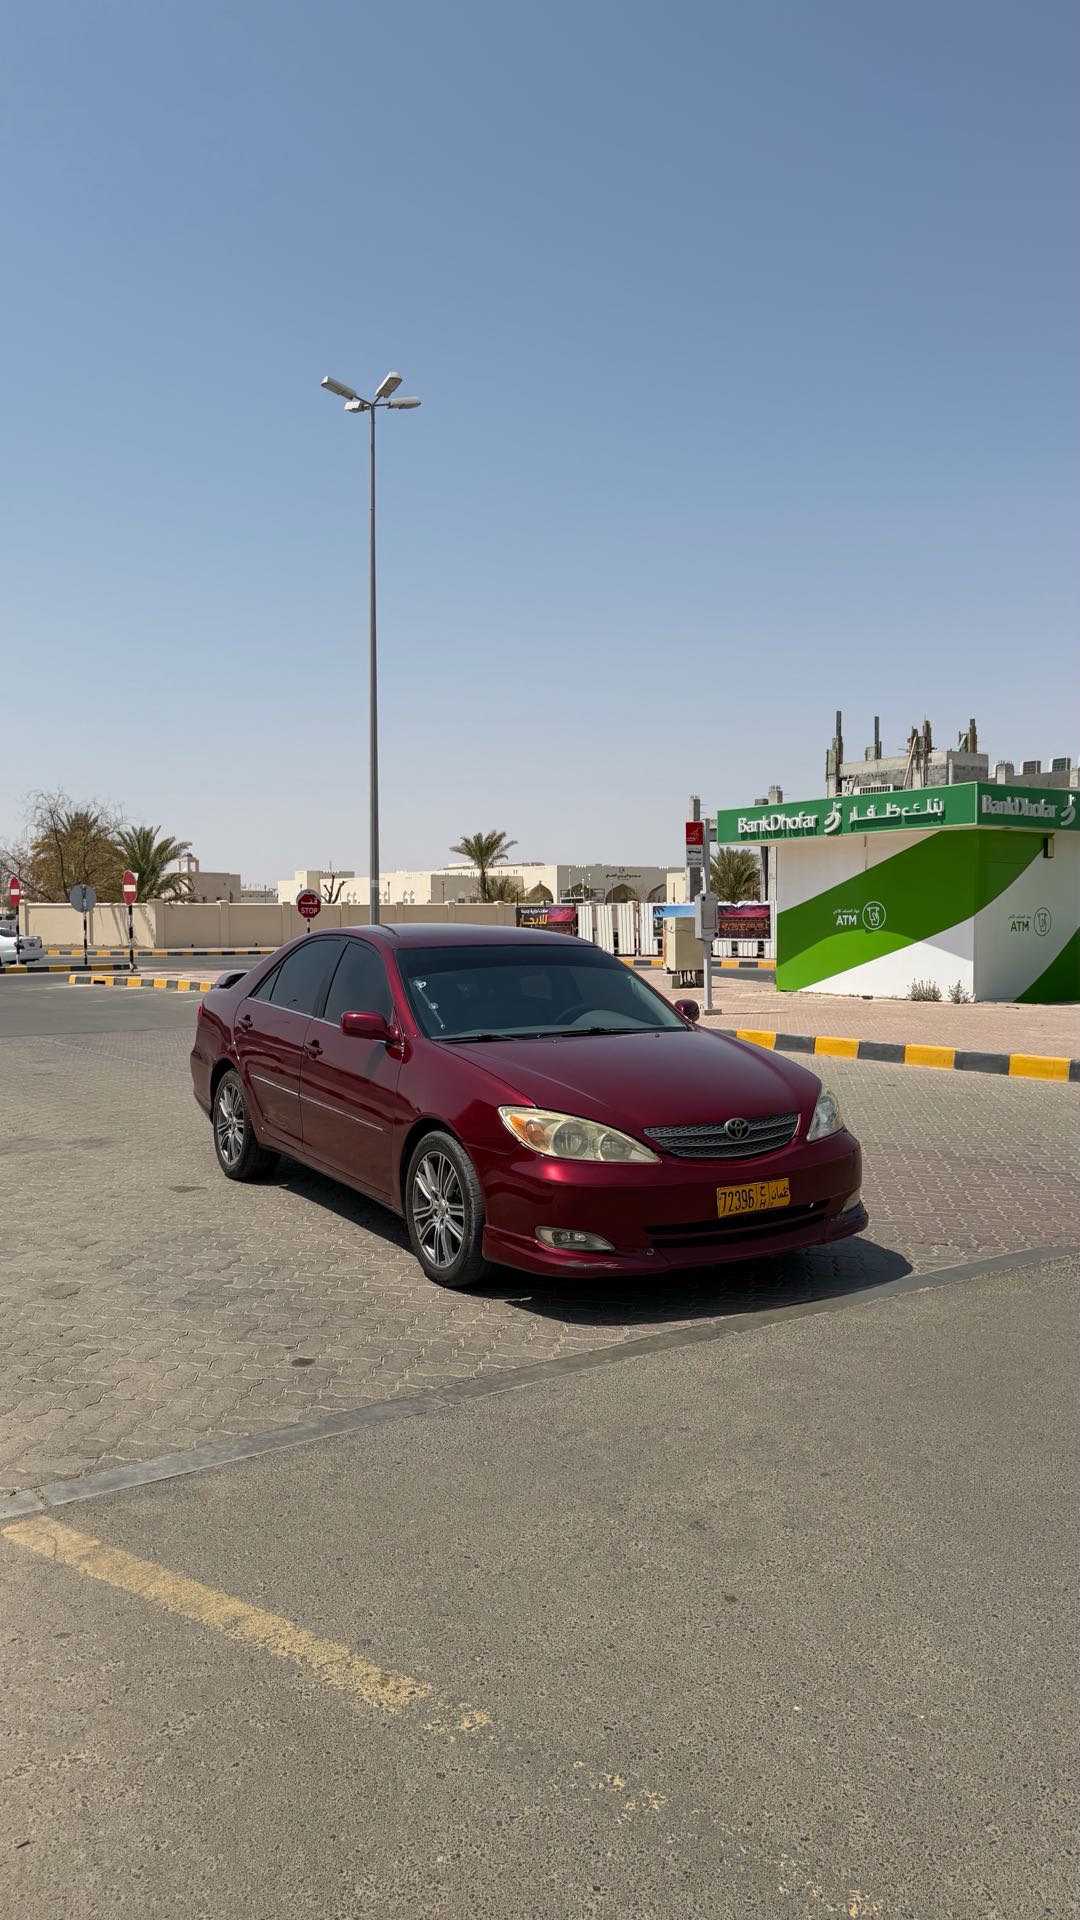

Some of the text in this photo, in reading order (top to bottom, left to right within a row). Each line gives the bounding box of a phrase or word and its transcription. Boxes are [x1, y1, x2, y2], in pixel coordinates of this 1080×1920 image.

[849, 797, 945, 824] بنك ظفار
[737, 812, 818, 833] BankDhofar
[300, 907, 318, 915] STOP
[835, 914, 857, 926] ATM
[1010, 920, 1030, 932] ATM
[719, 1188, 755, 1213] 72396
